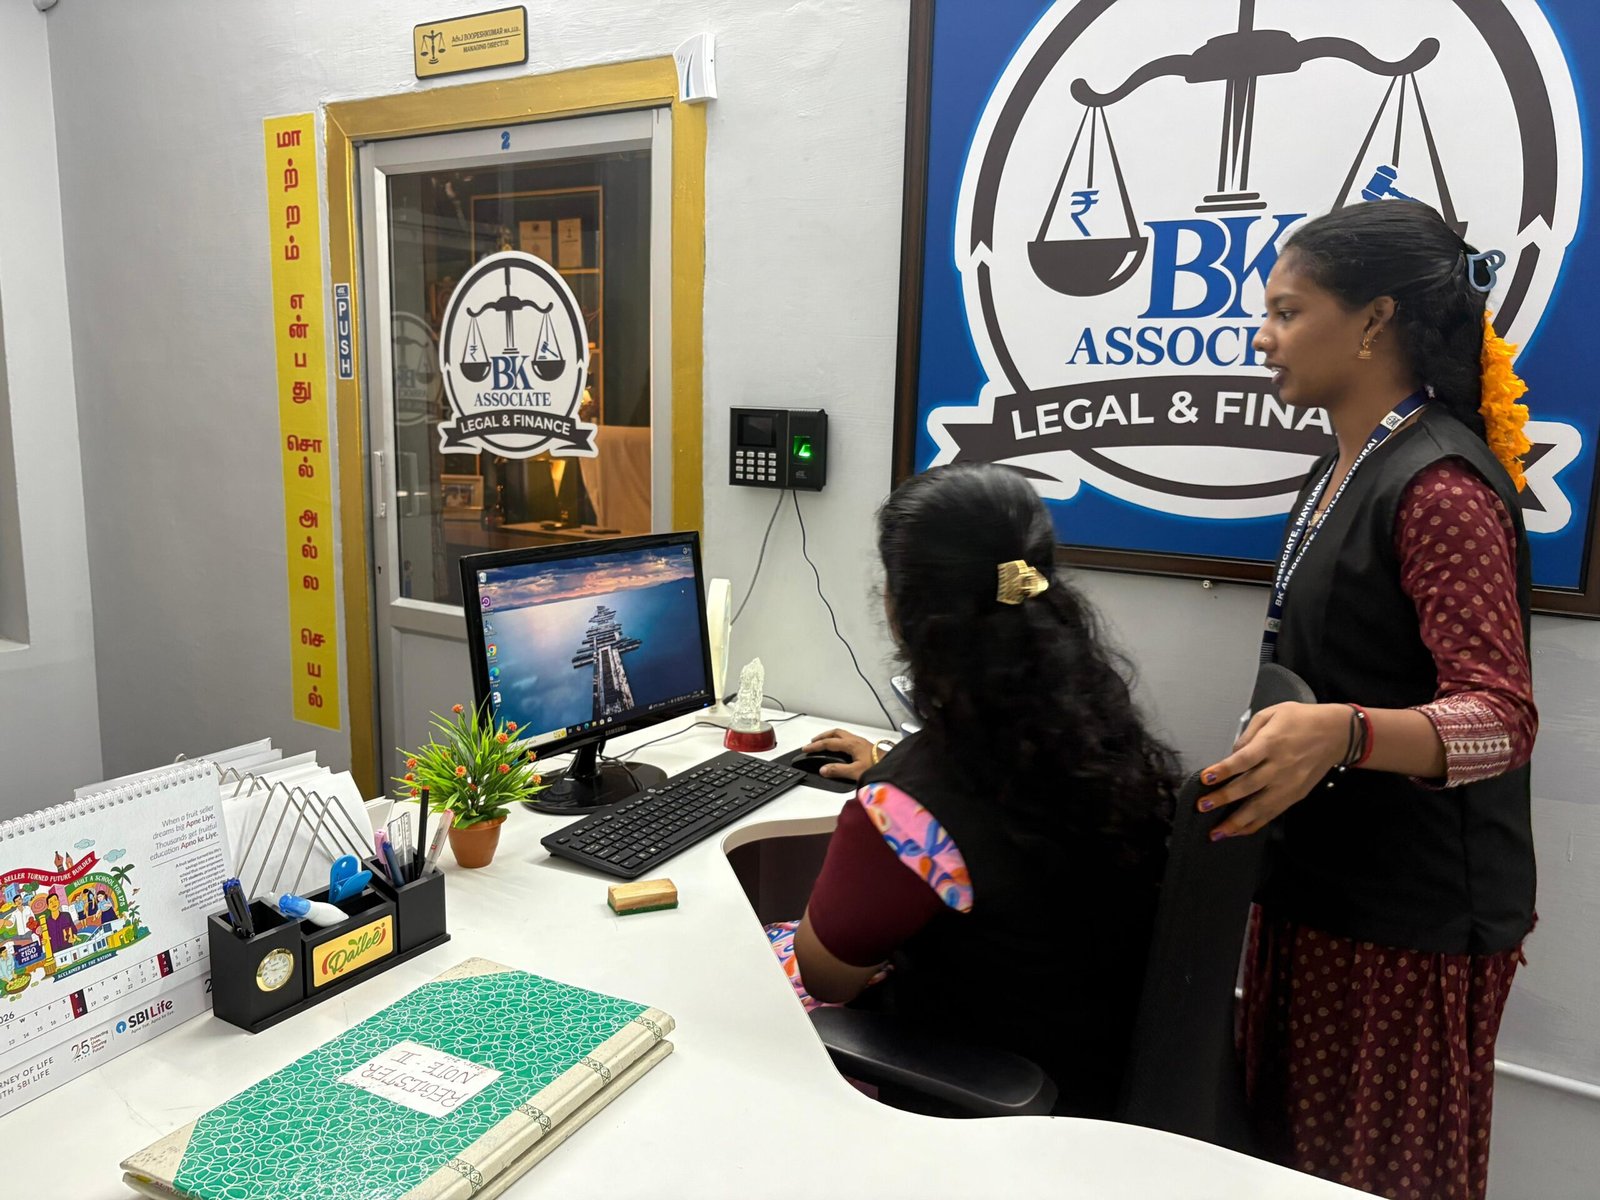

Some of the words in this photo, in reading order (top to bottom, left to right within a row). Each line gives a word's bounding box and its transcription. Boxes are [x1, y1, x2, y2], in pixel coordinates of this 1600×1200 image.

[501, 131, 510, 150] 2
[277, 130, 301, 260] மாற்றம்
[1137, 213, 1307, 319] BK
[289, 294, 311, 404] என்பது
[338, 301, 351, 374] PUSH
[1065, 326, 1268, 366] ASSOCI
[490, 355, 534, 391] BK
[474, 392, 552, 407] ASSOCIATE
[1011, 392, 1154, 441] LEGAL
[1167, 390, 1199, 425] &
[1214, 391, 1337, 436] FINA
[460, 416, 499, 434] LEGAL
[502, 414, 511, 427] &
[514, 414, 571, 436] FINANCE
[287, 434, 322, 478] சொல்
[299, 509, 319, 591] அல்ல
[1275, 591, 1285, 606] BK
[301, 628, 325, 708] செயல்
[4, 872, 26, 883] SELLER
[28, 872, 49, 881] TURNED
[50, 874, 71, 882] FUTURE
[72, 857, 93, 875] BUILDER
[74, 876, 88, 888] BUILT
[96, 875, 114, 886] SCHOOL
[328, 930, 381, 975] Dailee
[128, 1009, 150, 1028] SBI
[150, 1000, 173, 1018] Life
[23, 1066, 34, 1076] OF
[37, 1056, 54, 1070] LIFE
[71, 1040, 90, 1060] 25
[17, 1079, 30, 1090] SBI
[33, 1068, 50, 1082] LIFE
[361, 1063, 468, 1108] REGISTER
[422, 1061, 480, 1084] NOTE
